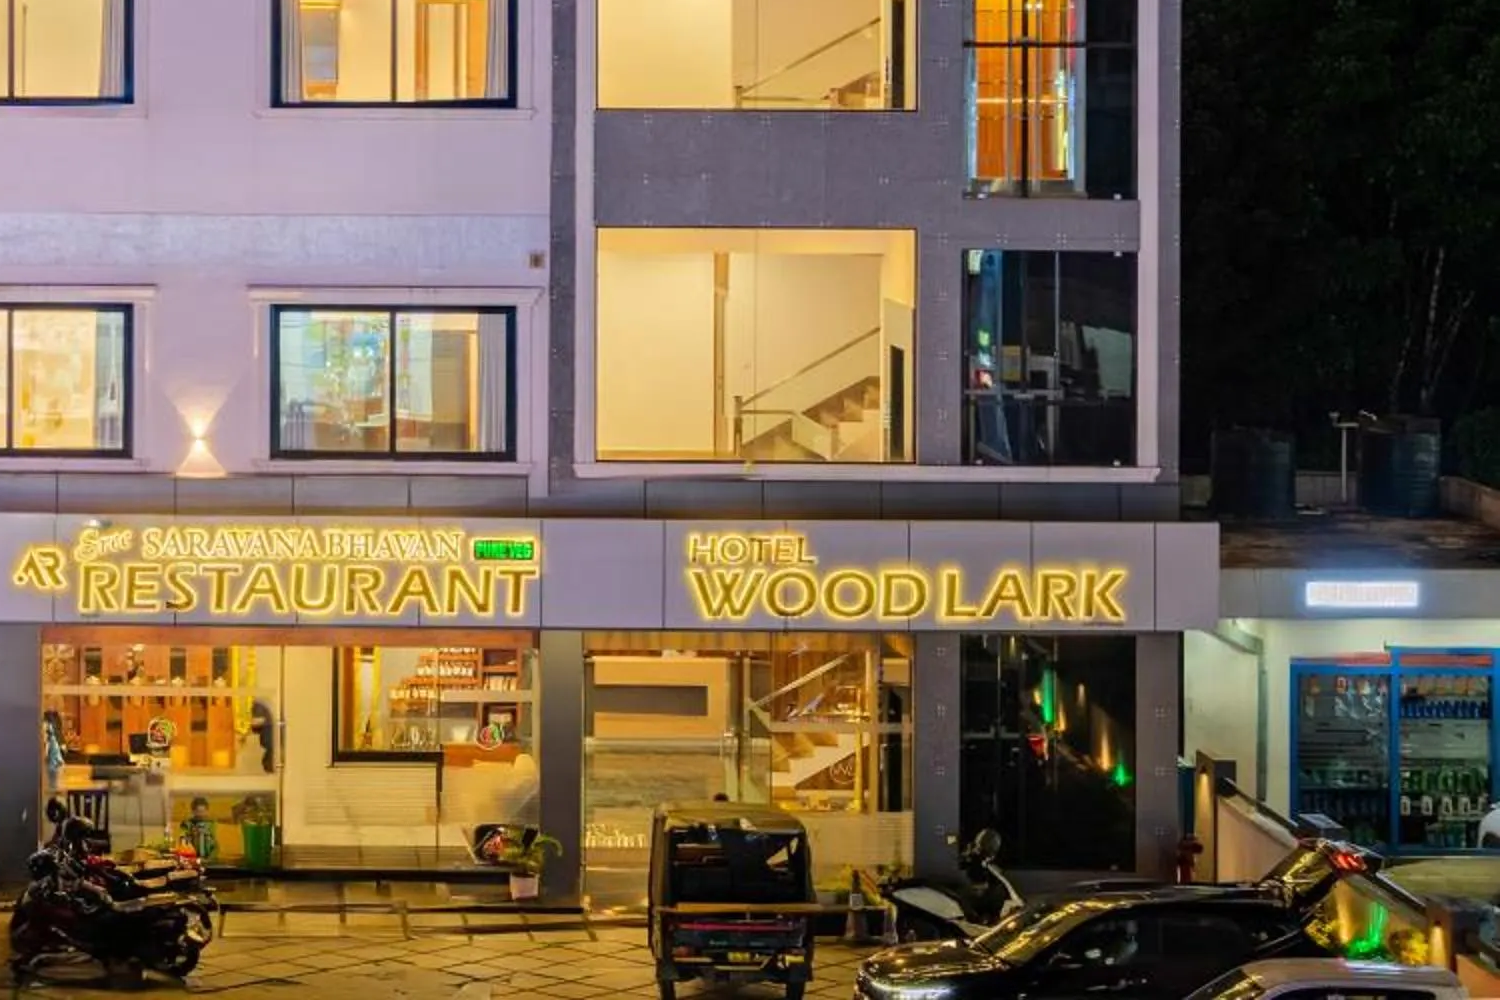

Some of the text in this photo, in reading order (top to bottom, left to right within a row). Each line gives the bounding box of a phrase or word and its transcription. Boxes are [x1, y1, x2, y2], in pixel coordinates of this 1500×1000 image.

[143, 528, 320, 559] SARAVANA
[324, 530, 464, 560] BHAVAN
[690, 535, 817, 565] HOTEL
[16, 548, 66, 588] AR
[79, 563, 538, 614] RESTAURANT
